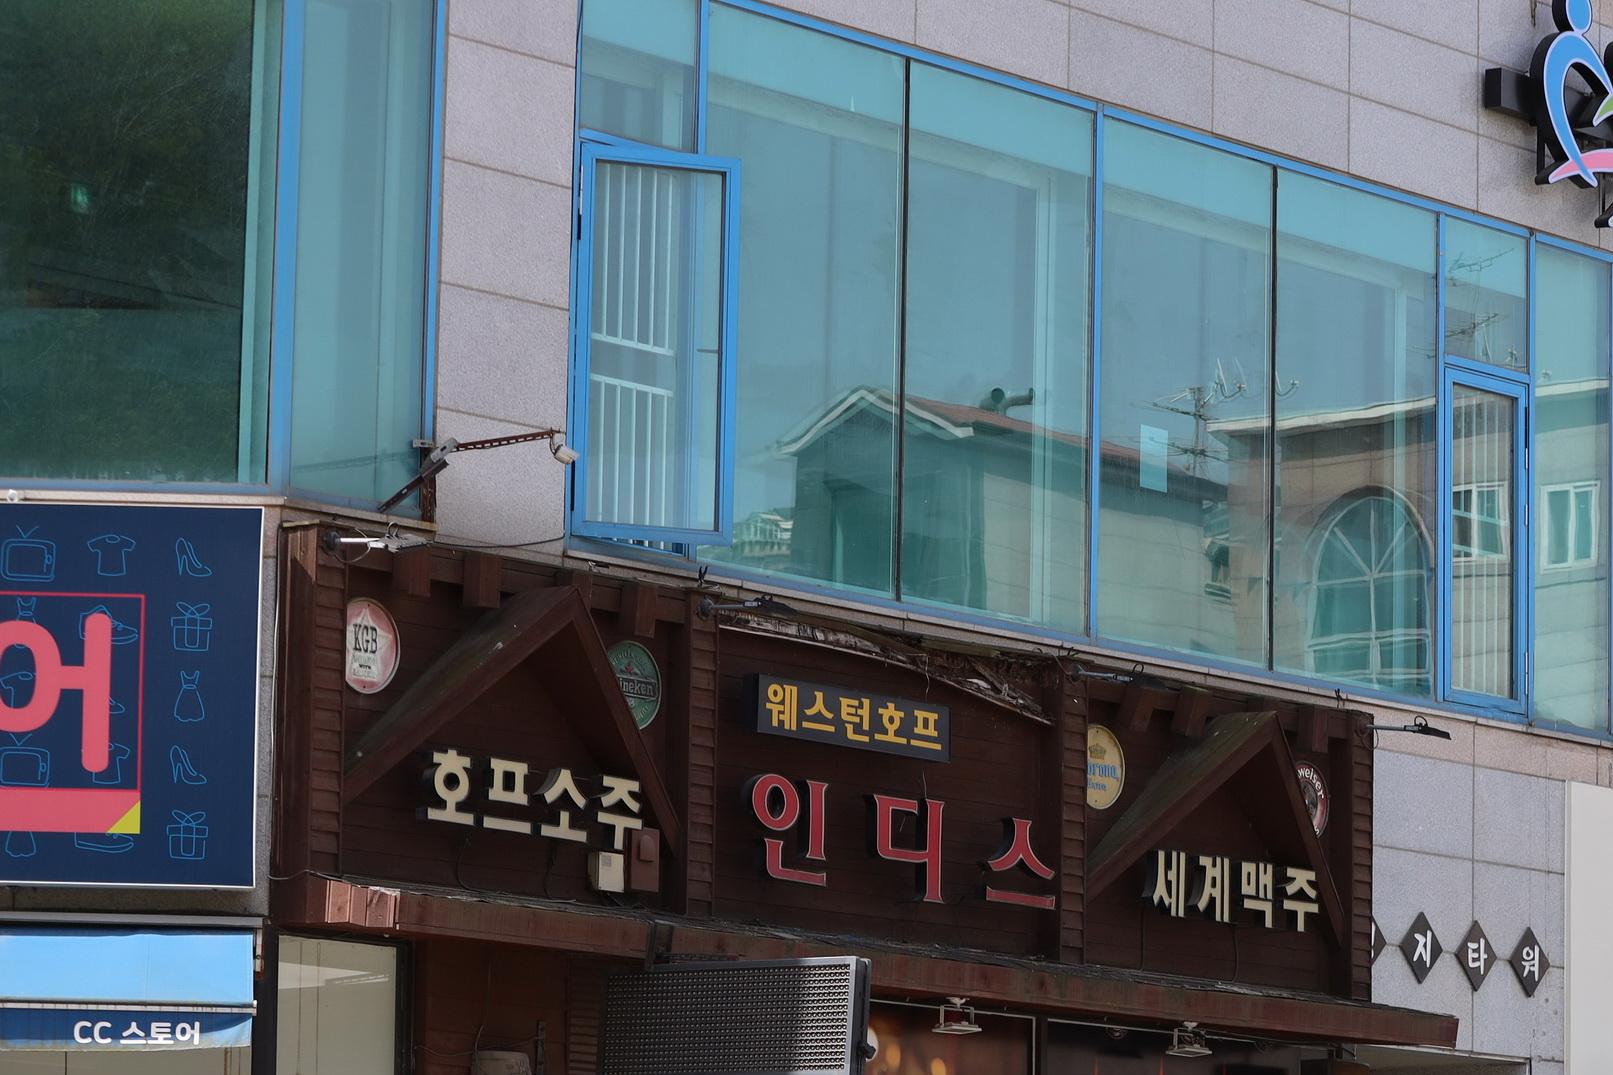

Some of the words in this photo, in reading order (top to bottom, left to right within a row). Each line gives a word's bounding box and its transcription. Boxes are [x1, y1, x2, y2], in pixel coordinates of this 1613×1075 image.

[352, 623, 379, 655] KGB
[619, 676, 655, 698] ineken
[765, 681, 942, 752] 웨스턴호프
[1088, 763, 1119, 781] orona
[427, 748, 643, 850] 호프소주
[1151, 848, 1320, 933] 세계맥주
[1372, 921, 1541, 983] 지타워
[73, 1020, 112, 1045] CC
[118, 1020, 202, 1046] 스토어
